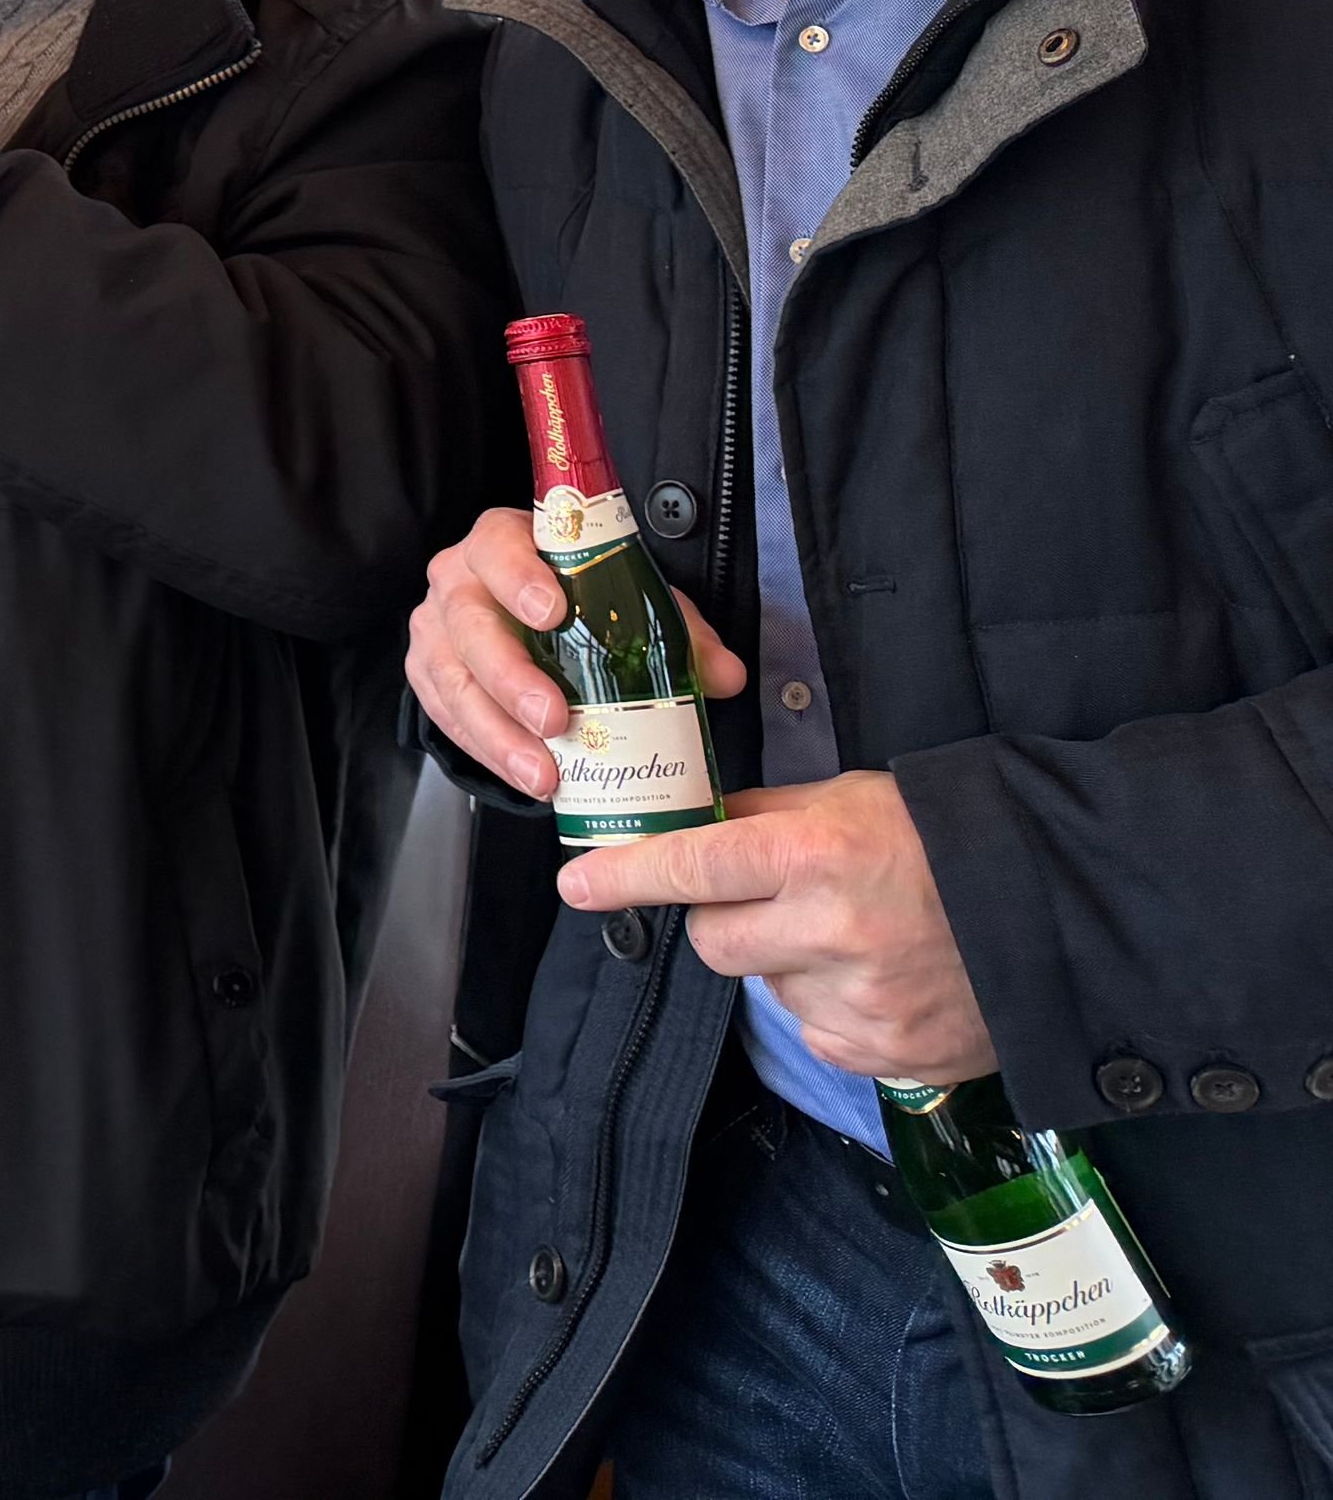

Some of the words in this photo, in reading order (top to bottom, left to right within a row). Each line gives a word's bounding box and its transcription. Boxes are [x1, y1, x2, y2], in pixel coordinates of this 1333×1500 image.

[540, 372, 570, 472] Rotkäppchen
[549, 550, 591, 562] TROCKEN
[610, 793, 672, 804] KOMPOSITION
[584, 818, 643, 830] TROCKEN
[964, 1277, 1112, 1326] Rotkäppchen
[1044, 1317, 1107, 1339] KOMPOSITION
[1024, 1349, 1086, 1363] TROCKEN
